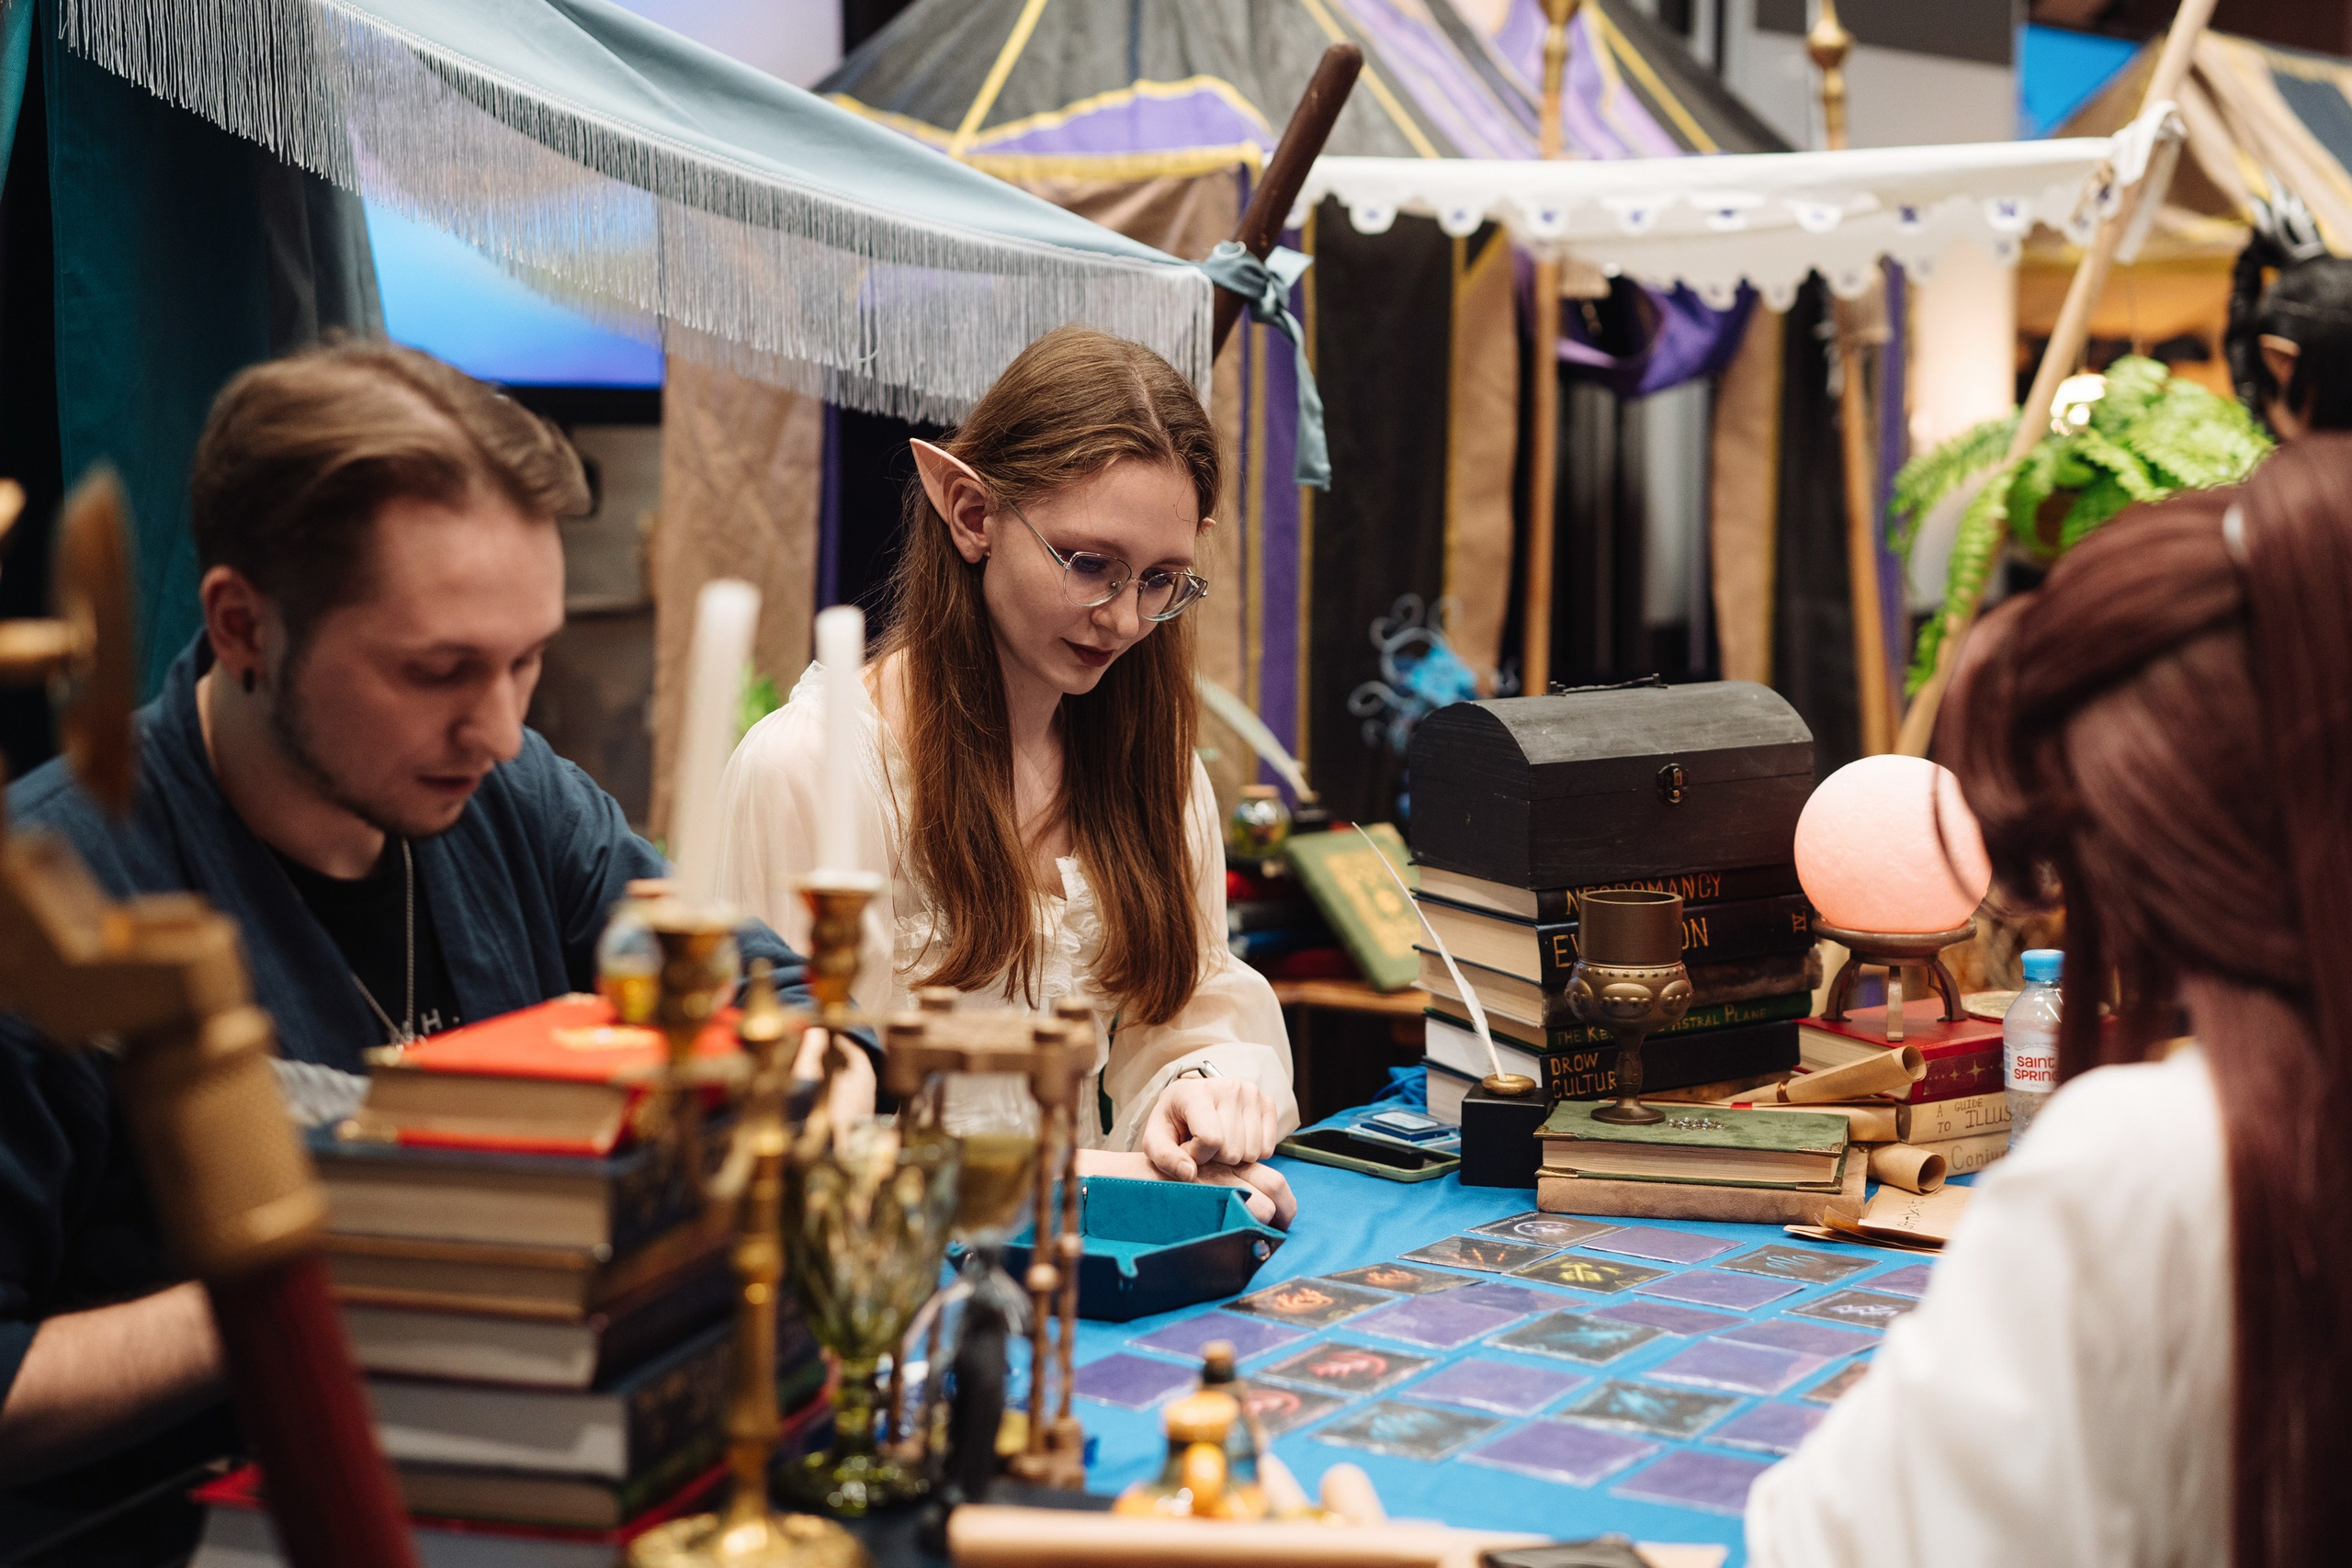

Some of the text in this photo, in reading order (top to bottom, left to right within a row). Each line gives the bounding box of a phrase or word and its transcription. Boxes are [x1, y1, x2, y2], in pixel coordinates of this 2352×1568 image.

[1555, 1029, 1582, 1045] THE
[1550, 1052, 1599, 1077] DROW
[1552, 1070, 1618, 1100] CULTUR
[1937, 1098, 1984, 1118] A GUIDE
[1938, 1105, 2012, 1134] TO ILLUS
